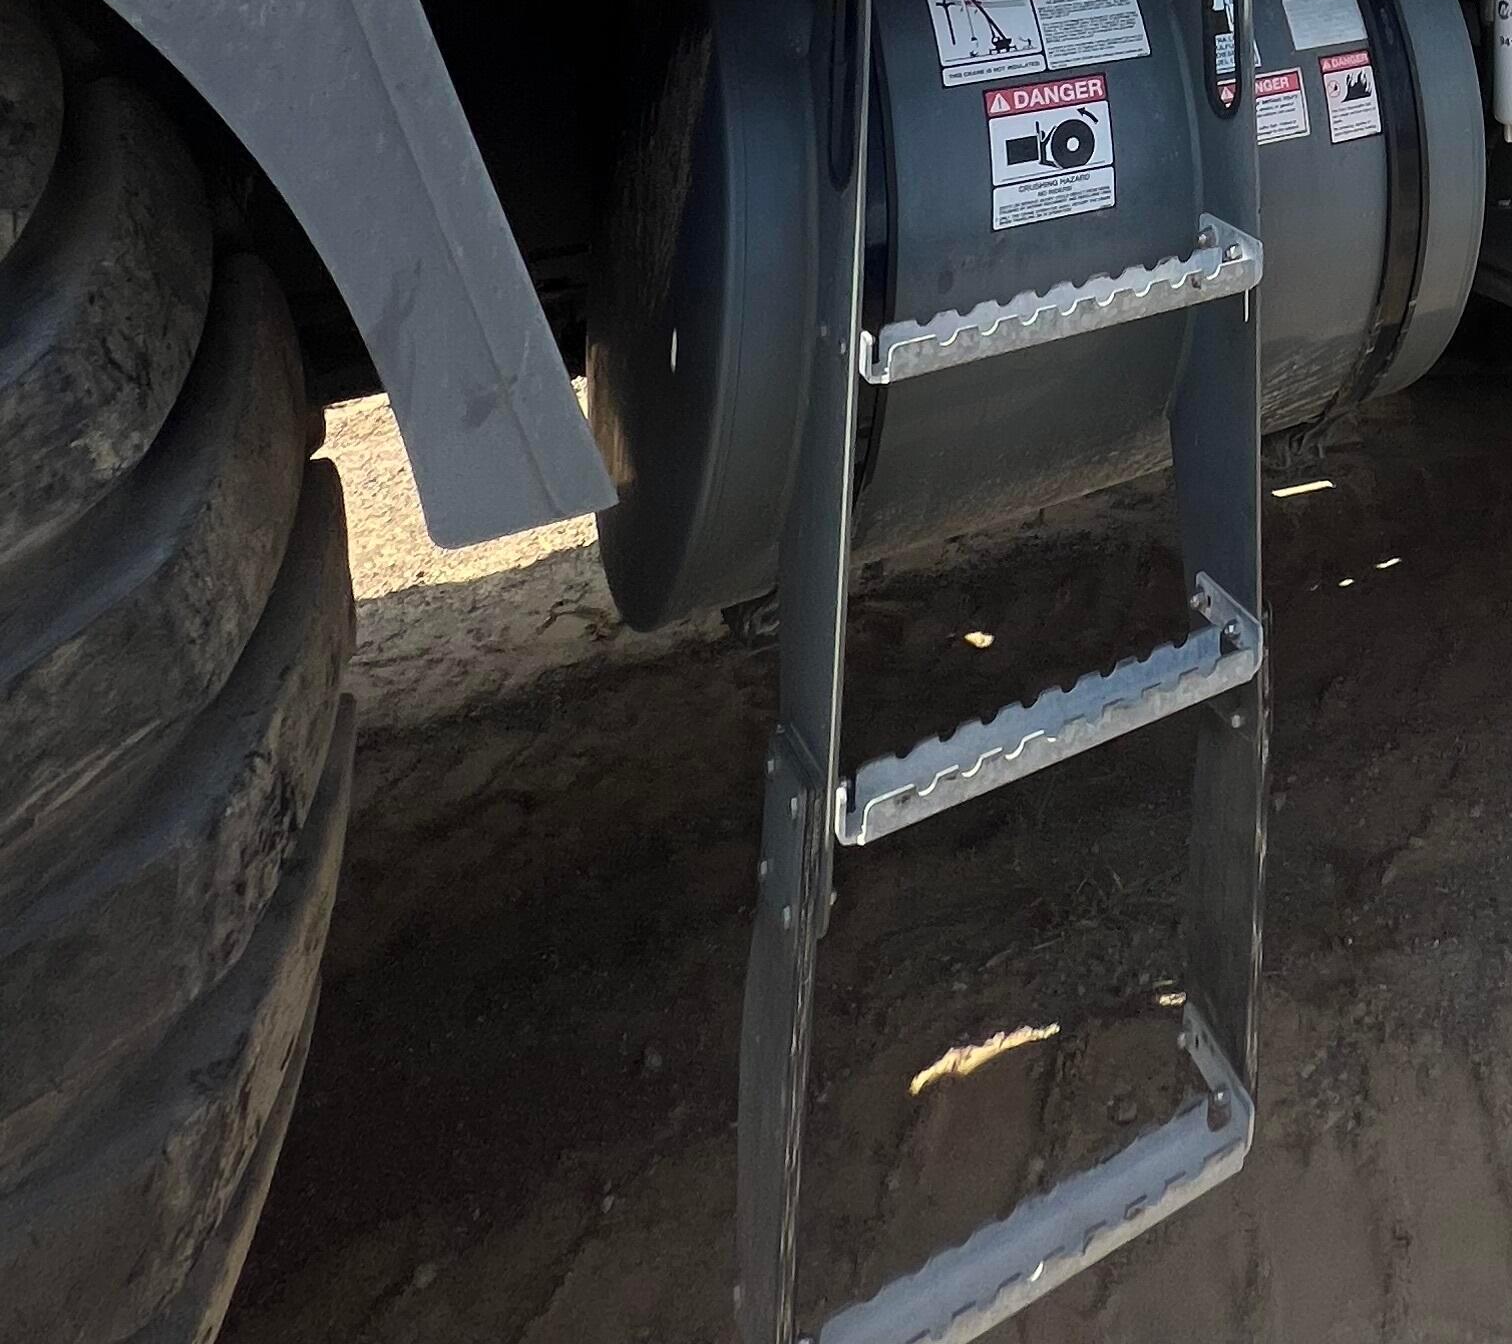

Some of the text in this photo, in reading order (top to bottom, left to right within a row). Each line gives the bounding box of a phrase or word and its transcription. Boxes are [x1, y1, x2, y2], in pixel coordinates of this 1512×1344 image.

[1331, 53, 1370, 68] DANGER
[1013, 78, 1104, 110] DANGER
[1059, 173, 1091, 185] HAZARD
